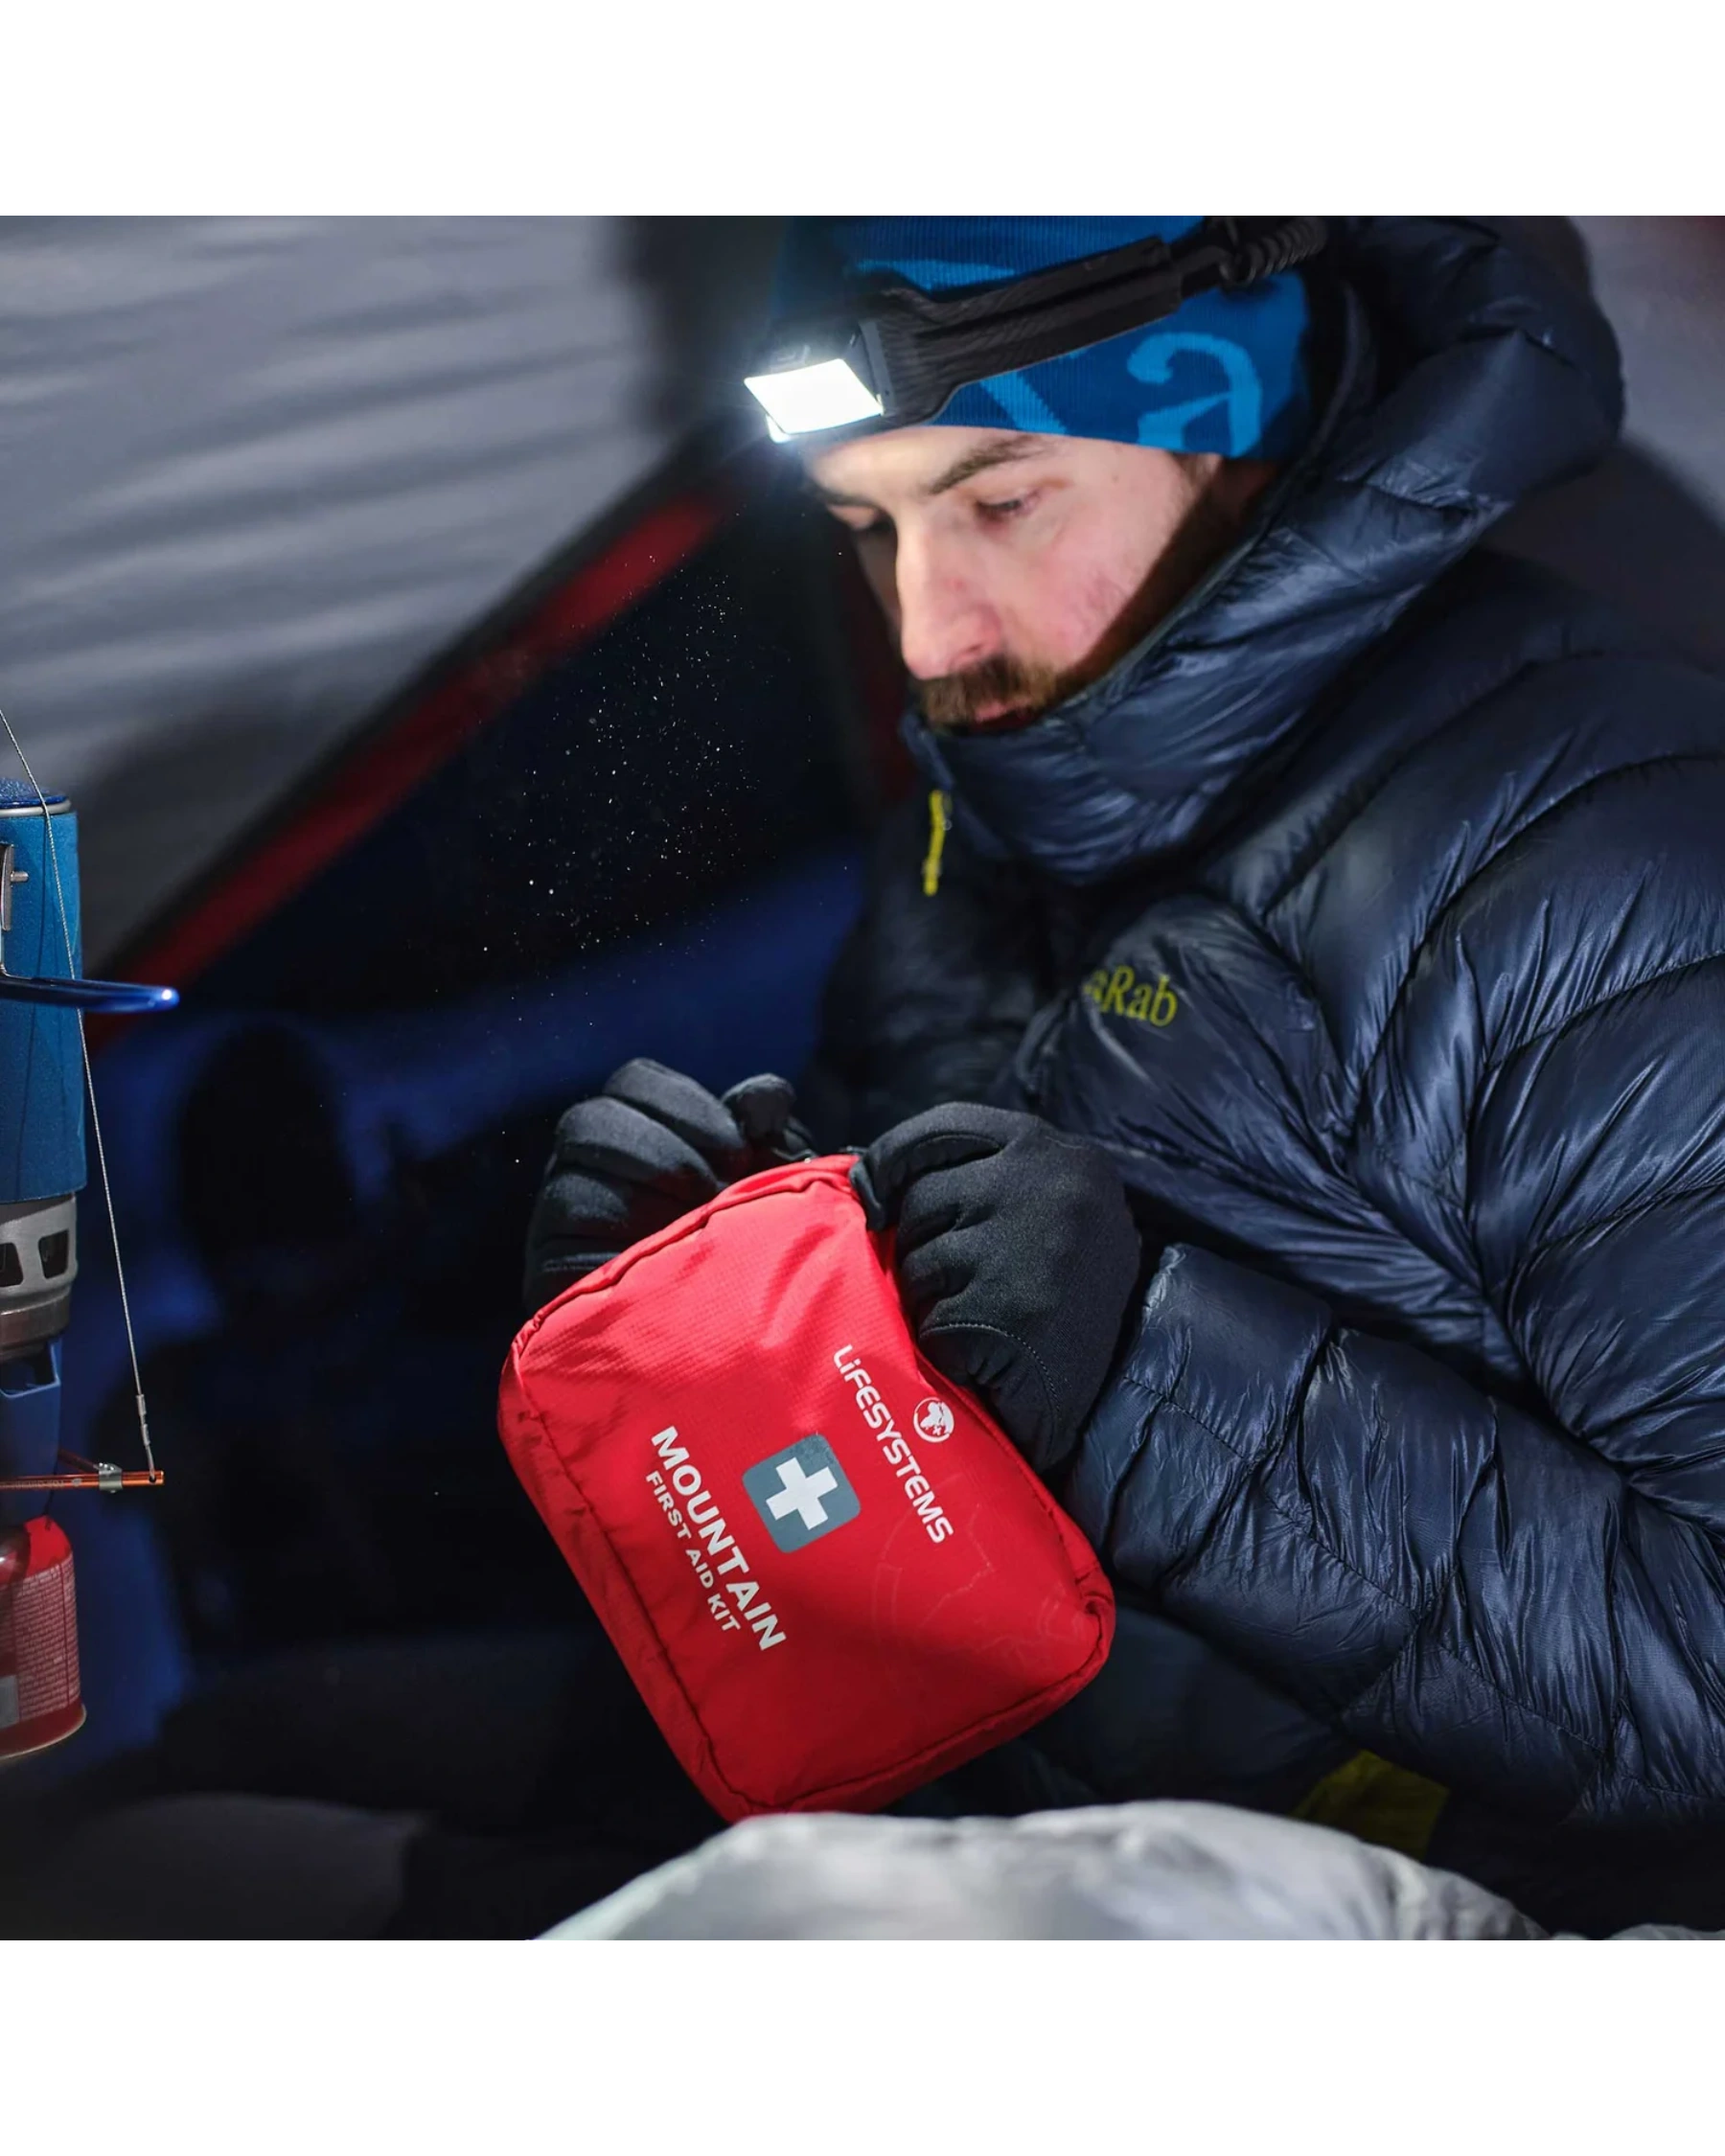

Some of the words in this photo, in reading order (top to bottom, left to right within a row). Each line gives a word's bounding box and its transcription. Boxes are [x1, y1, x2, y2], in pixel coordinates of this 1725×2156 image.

[1099, 964, 1178, 1027] Rab
[646, 1470, 692, 1539] FIRST
[685, 1548, 714, 1589] AID
[707, 1593, 741, 1631] KIT
[651, 1426, 787, 1651] MOUNTAIN
